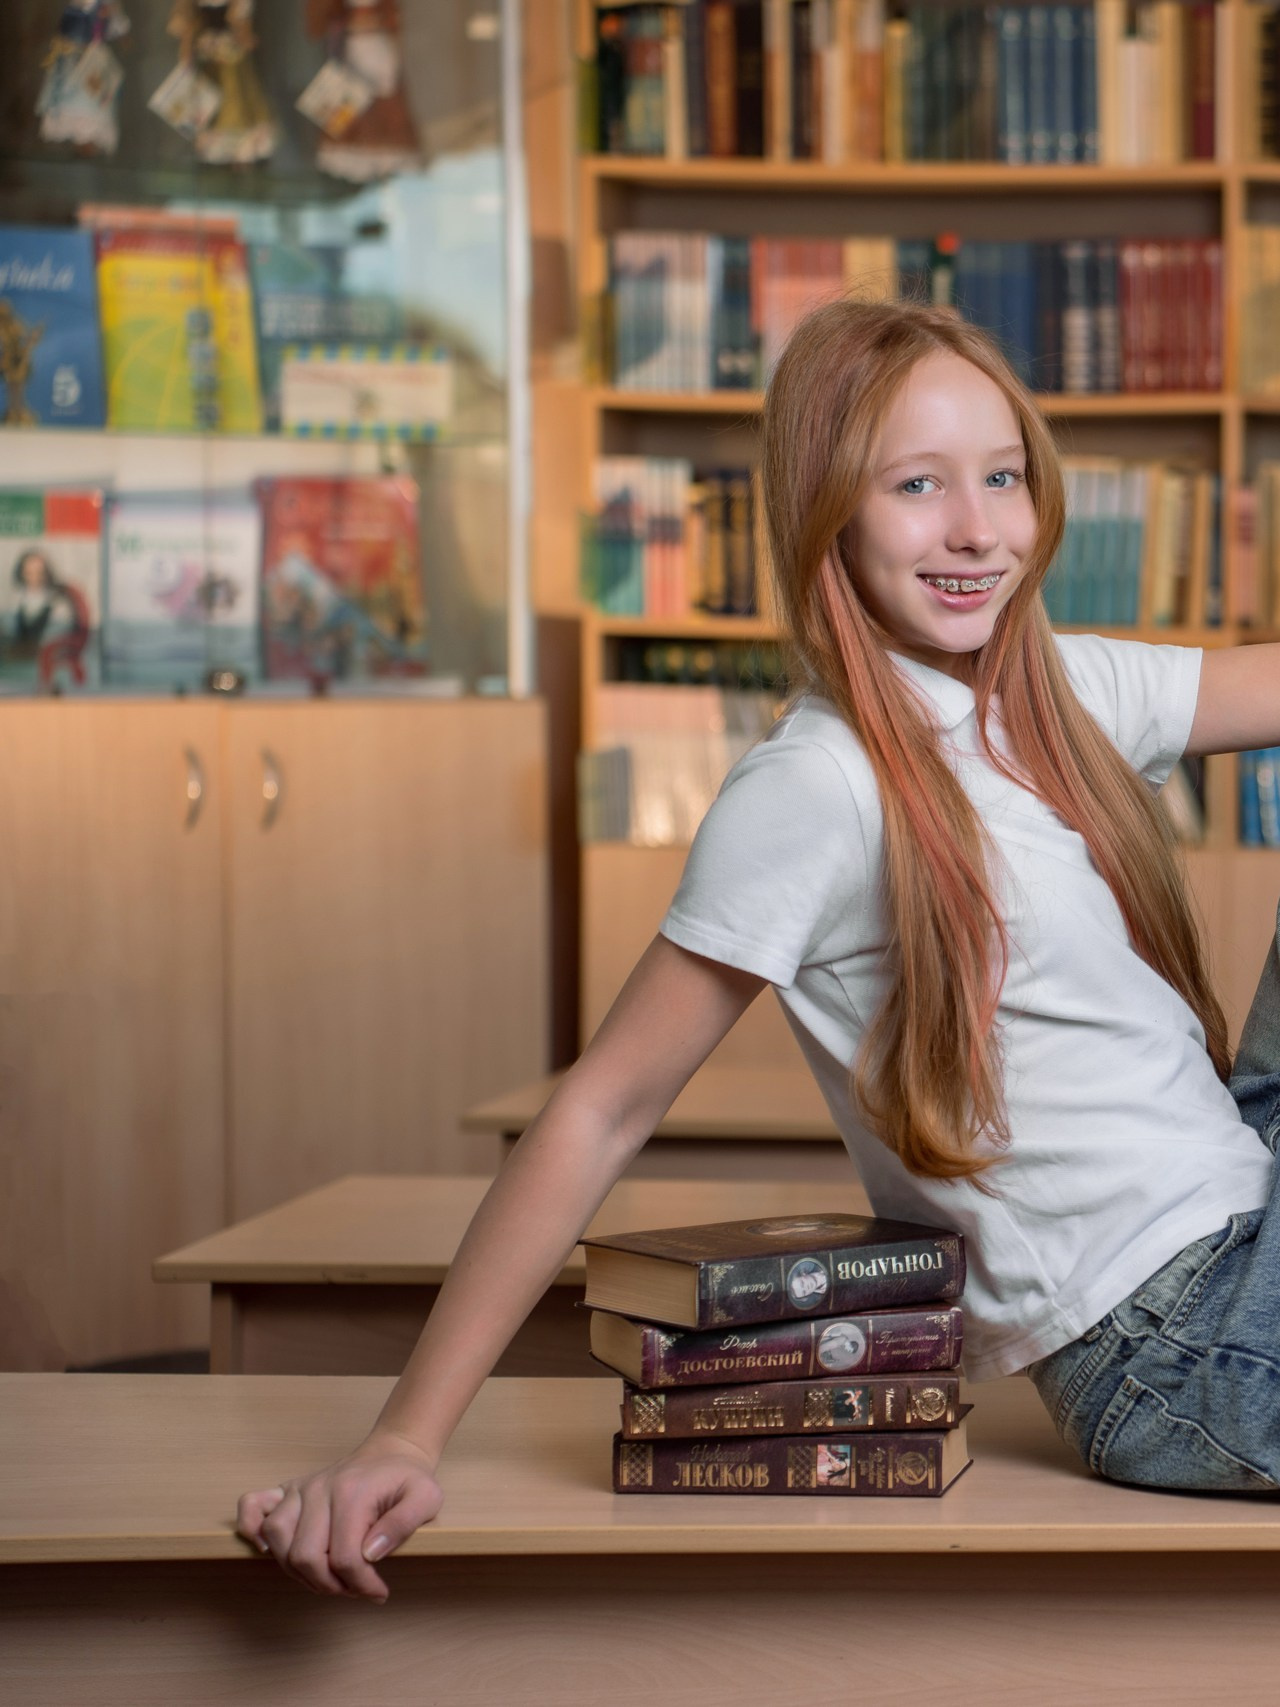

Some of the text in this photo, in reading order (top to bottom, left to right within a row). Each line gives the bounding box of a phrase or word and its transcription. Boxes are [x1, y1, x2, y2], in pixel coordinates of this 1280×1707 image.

[837, 1251, 944, 1280] ГОНЧАРОВ
[677, 1350, 804, 1375] ДОСТОЕВСКИЙ
[693, 1406, 785, 1431] КУПРИН
[672, 1462, 770, 1488] ЛЕСКОВ
